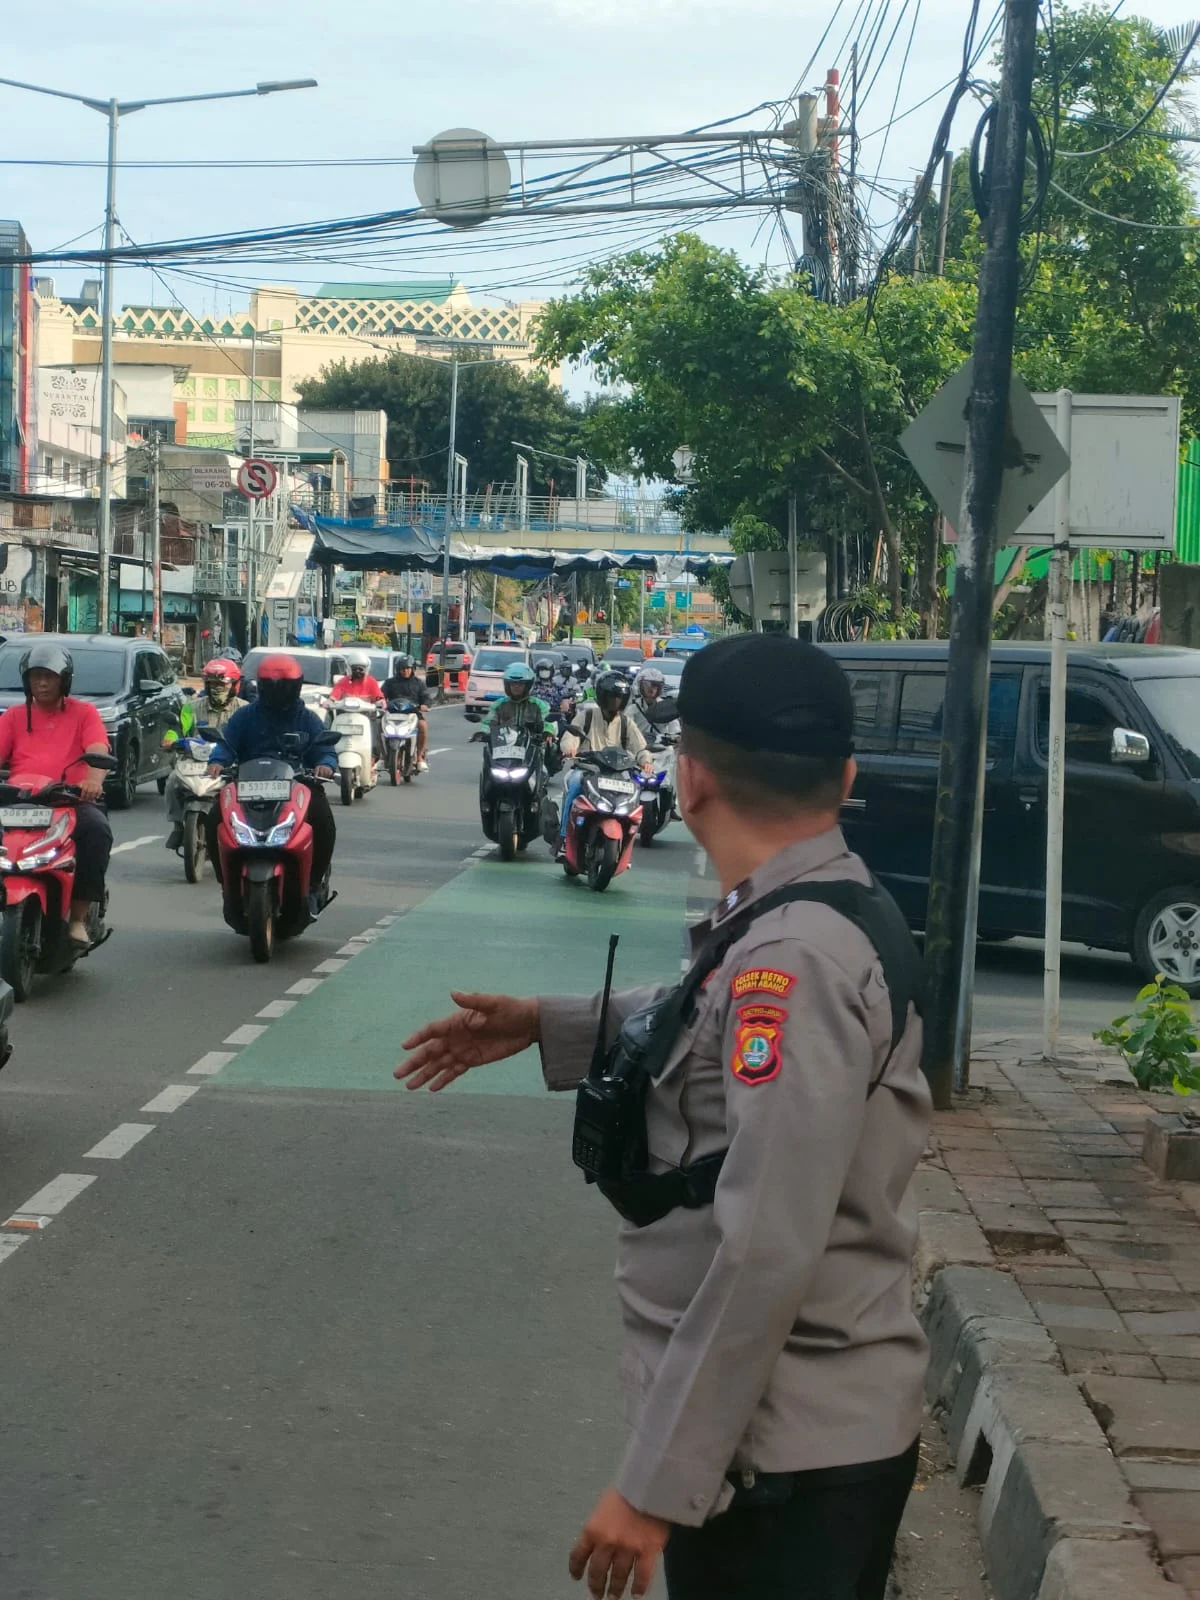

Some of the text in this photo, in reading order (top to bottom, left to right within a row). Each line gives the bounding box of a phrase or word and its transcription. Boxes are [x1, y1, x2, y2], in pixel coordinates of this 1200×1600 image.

[194, 467, 228, 475] DILARANG
[205, 481, 231, 489] 06-20
[736, 971, 789, 986] POLSEK METRO
[758, 980, 785, 993] ABANG
